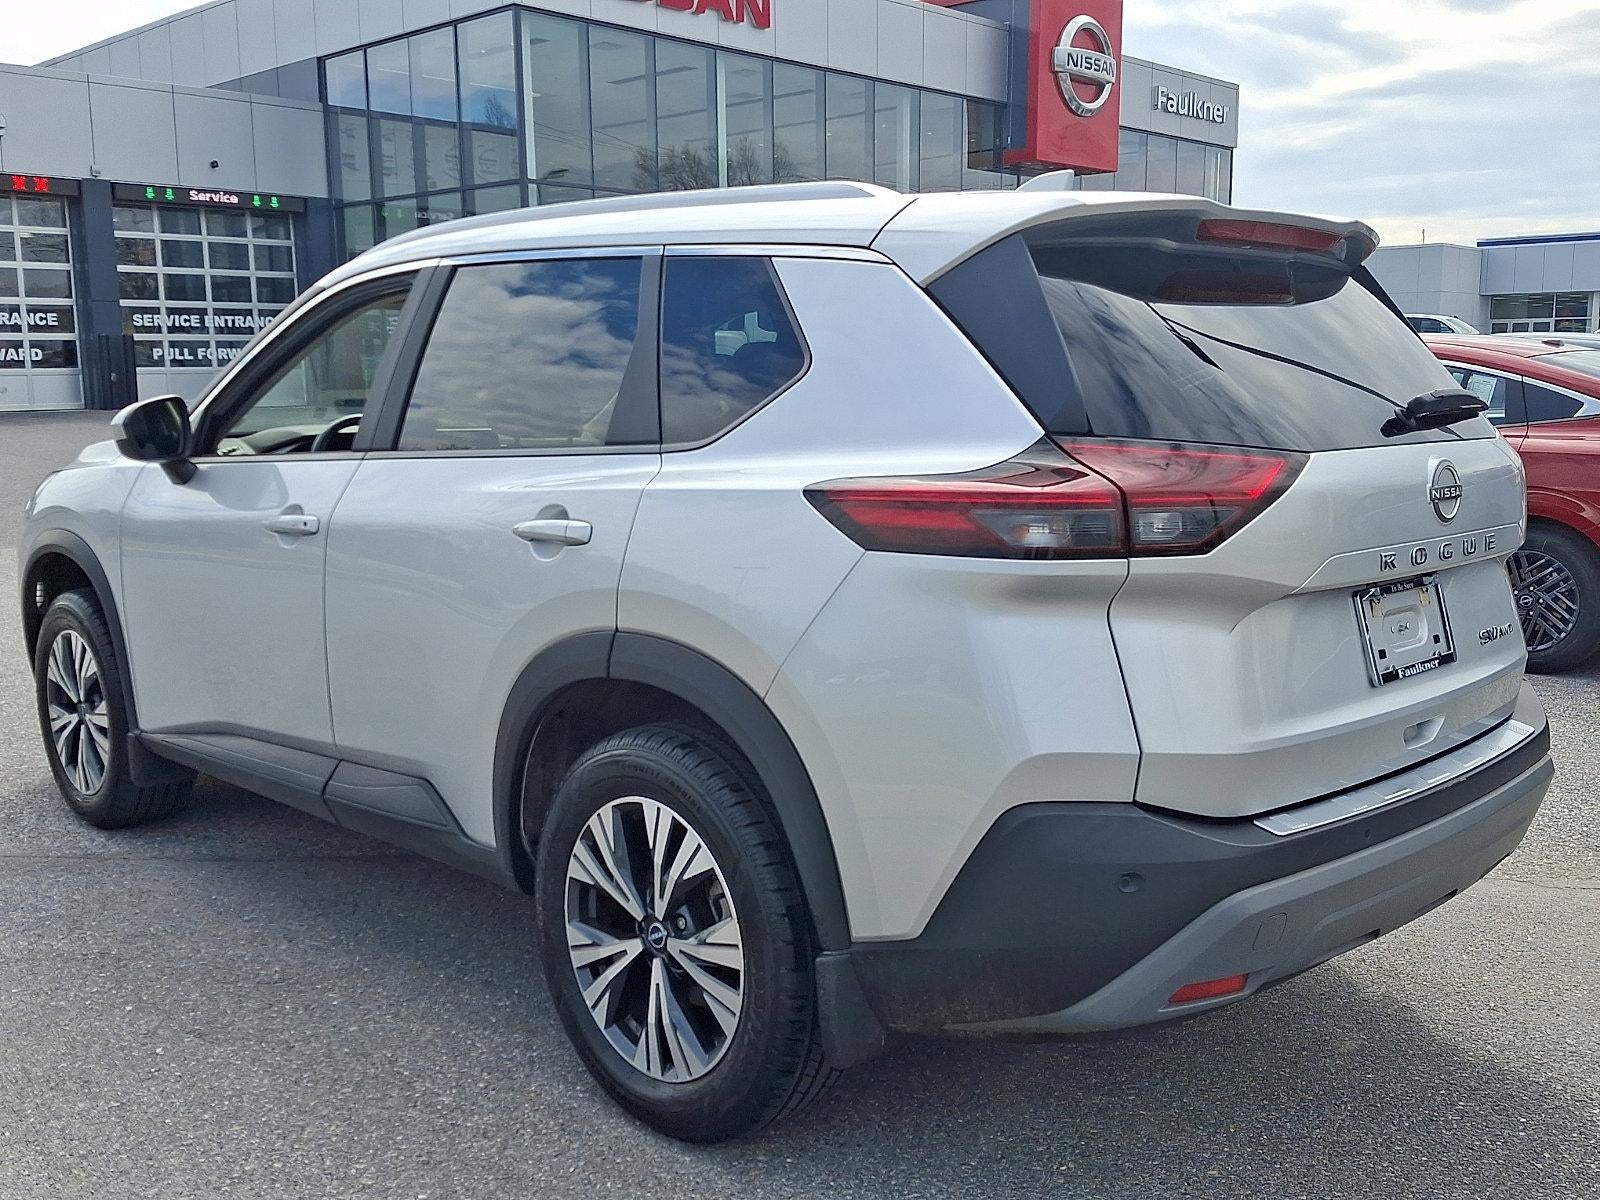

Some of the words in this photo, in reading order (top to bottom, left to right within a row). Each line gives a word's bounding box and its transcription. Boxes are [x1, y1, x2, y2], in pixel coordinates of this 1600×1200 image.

[1066, 52, 1115, 78] NISSAN
[1155, 85, 1230, 124] Faulkner
[189, 189, 239, 204] Service
[132, 313, 201, 327] SERVICE
[152, 348, 194, 360] PULL
[1380, 534, 1497, 572] ROGUE
[1397, 659, 1440, 680] Faulkner
